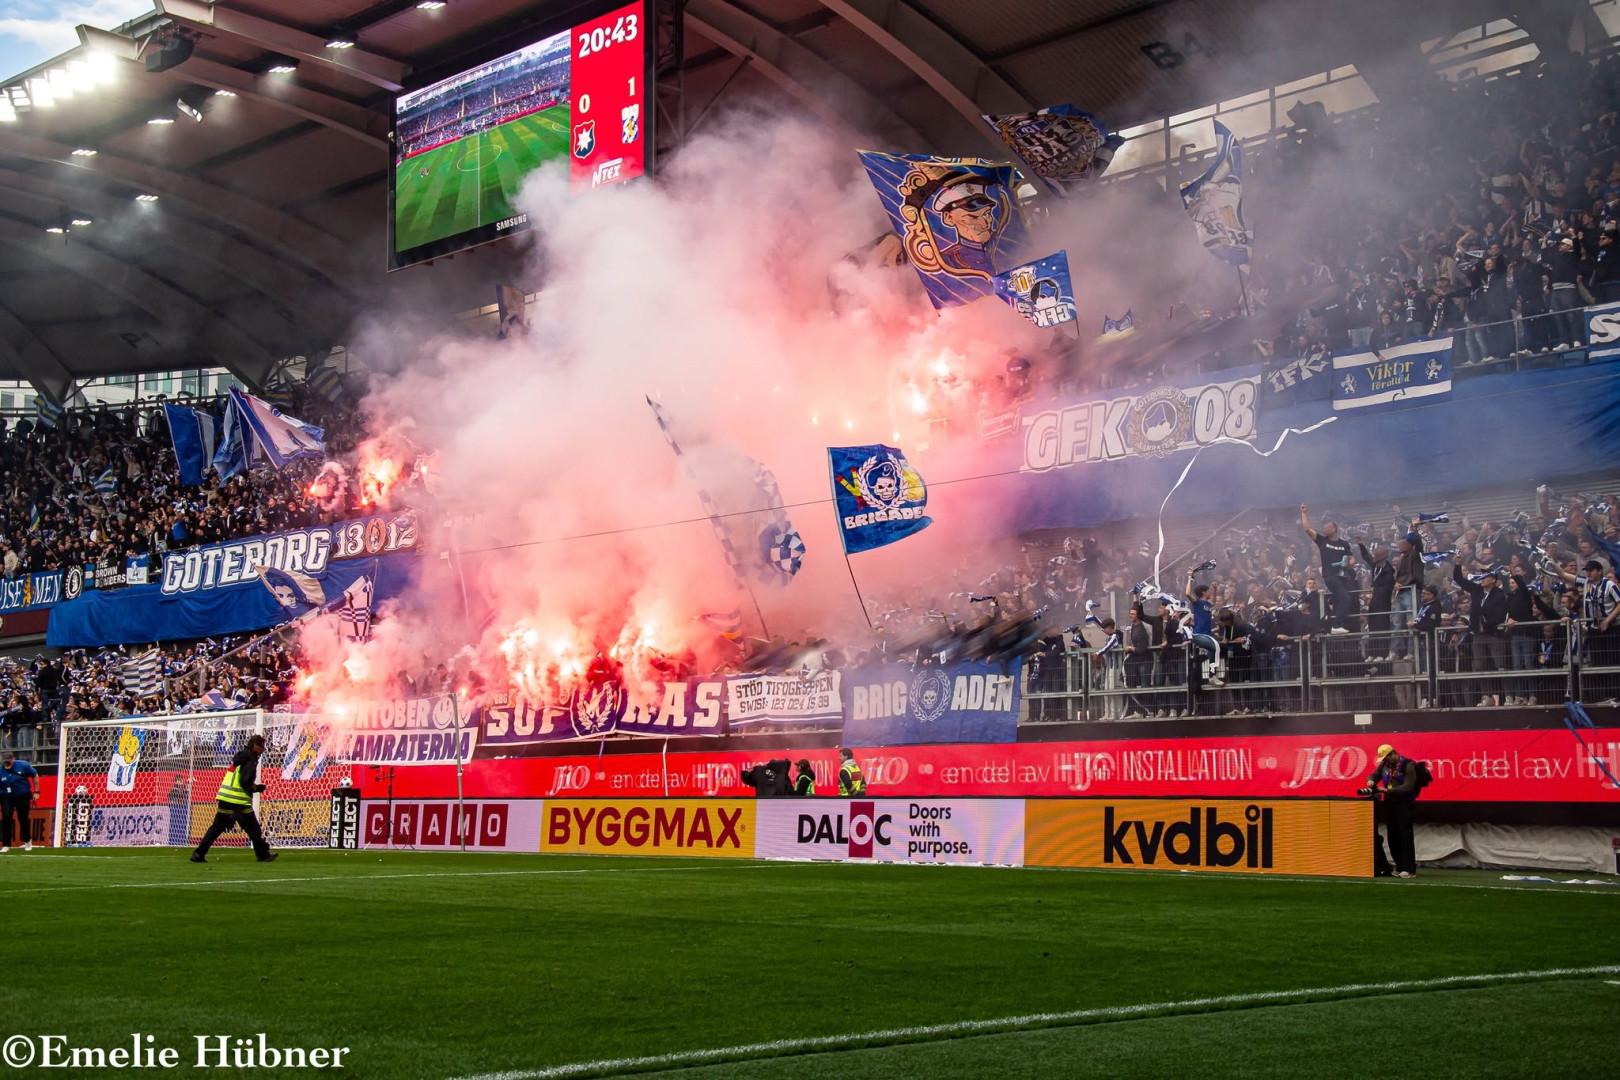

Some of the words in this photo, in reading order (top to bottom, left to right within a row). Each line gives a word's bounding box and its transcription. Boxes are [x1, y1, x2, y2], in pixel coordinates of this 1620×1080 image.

[578, 14, 638, 58] 20:43
[628, 76, 636, 97] 1
[578, 94, 591, 114] 0
[496, 213, 527, 231] SAMSUNG
[1025, 398, 1131, 470] GFK
[1194, 380, 1256, 445] 08
[95, 566, 118, 578] BROWN
[32, 574, 63, 605] MEN
[735, 679, 763, 699] STÖD
[853, 680, 908, 720] BRIG
[950, 674, 1015, 712] ADEN
[770, 698, 785, 710] 123
[345, 731, 470, 761] AMRATERNA
[75, 801, 91, 842] SELECT
[330, 795, 342, 848] SELECT
[342, 796, 359, 849] SELECT
[370, 811, 502, 838] CRAMO
[908, 803, 951, 820] Doors
[107, 815, 164, 840] gyproc
[797, 813, 892, 845] DALOC
[908, 820, 940, 838] with
[907, 839, 973, 858] purpose.
